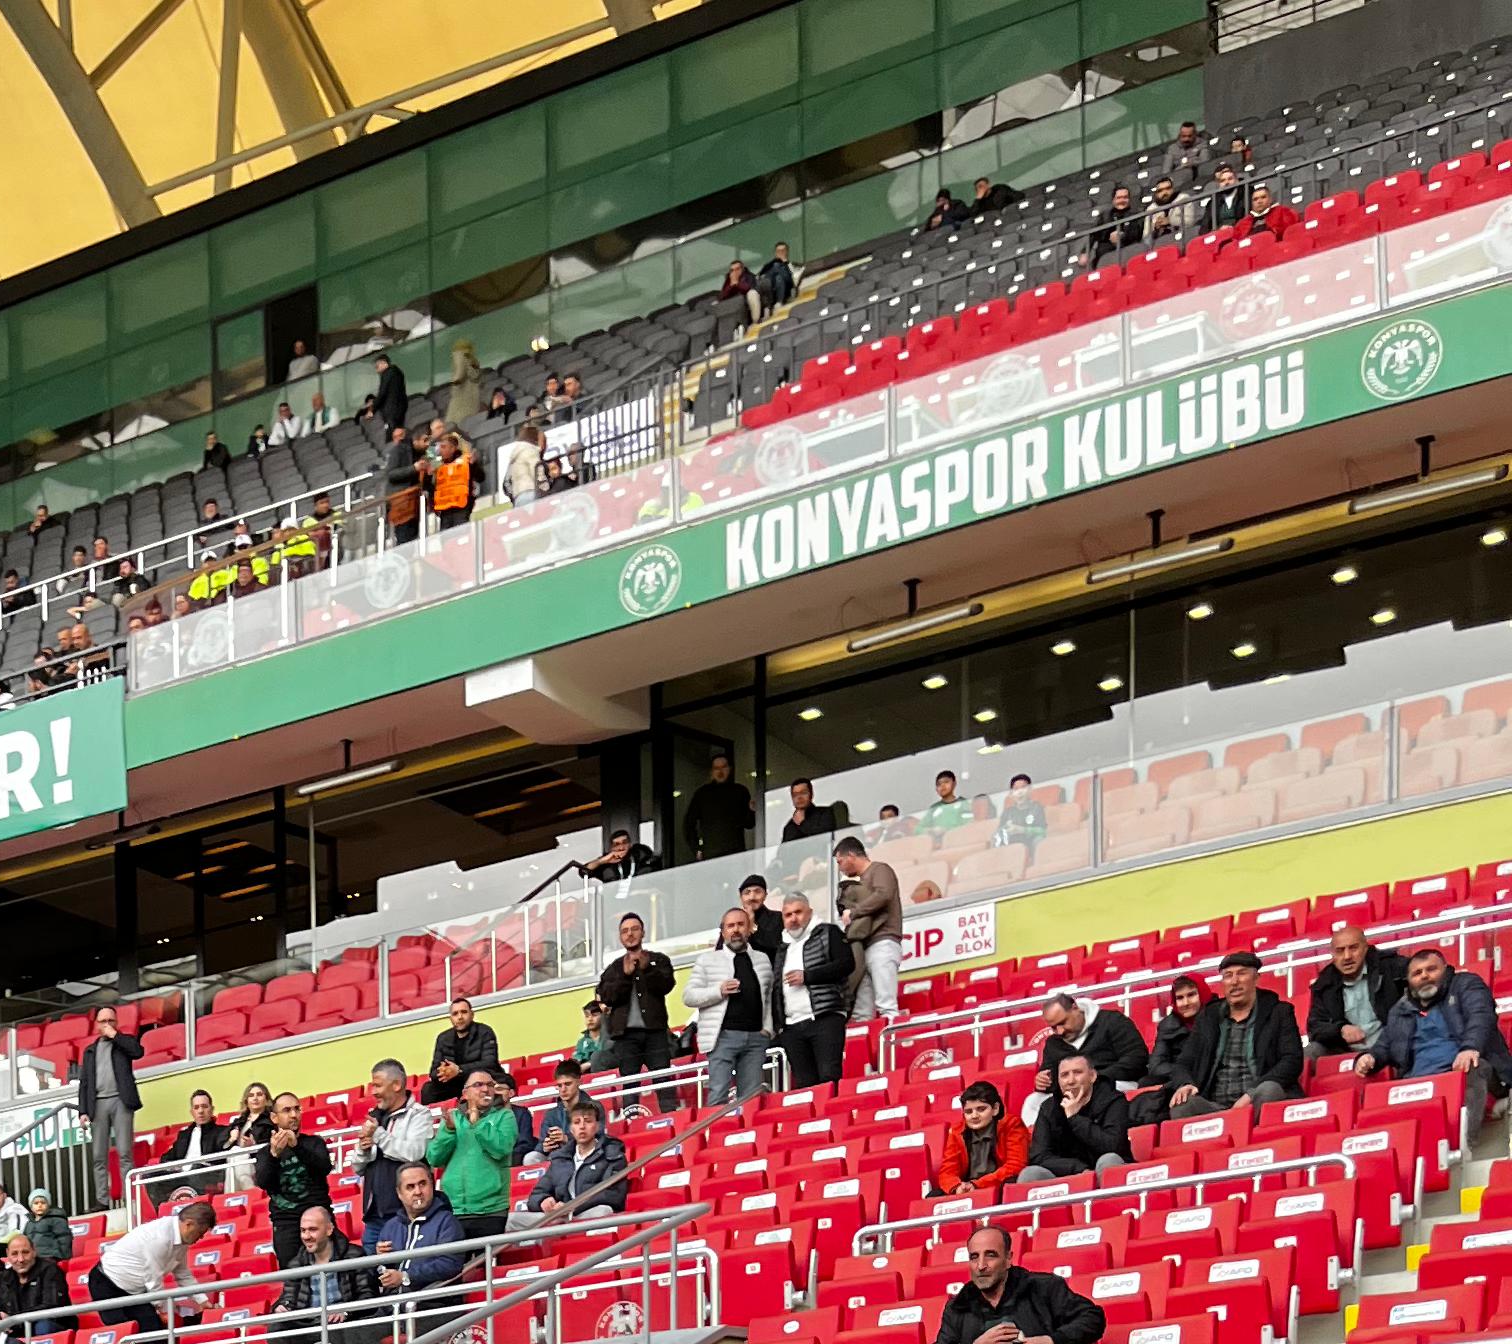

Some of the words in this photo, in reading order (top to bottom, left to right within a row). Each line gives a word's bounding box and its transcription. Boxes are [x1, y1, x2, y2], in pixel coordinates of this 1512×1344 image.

[725, 425, 1047, 591] KONYASPOR
[1063, 350, 1306, 492] KULÜBÜ
[958, 912, 989, 928] BATI
[961, 926, 986, 940] ALT
[955, 938, 992, 955] BLOK
